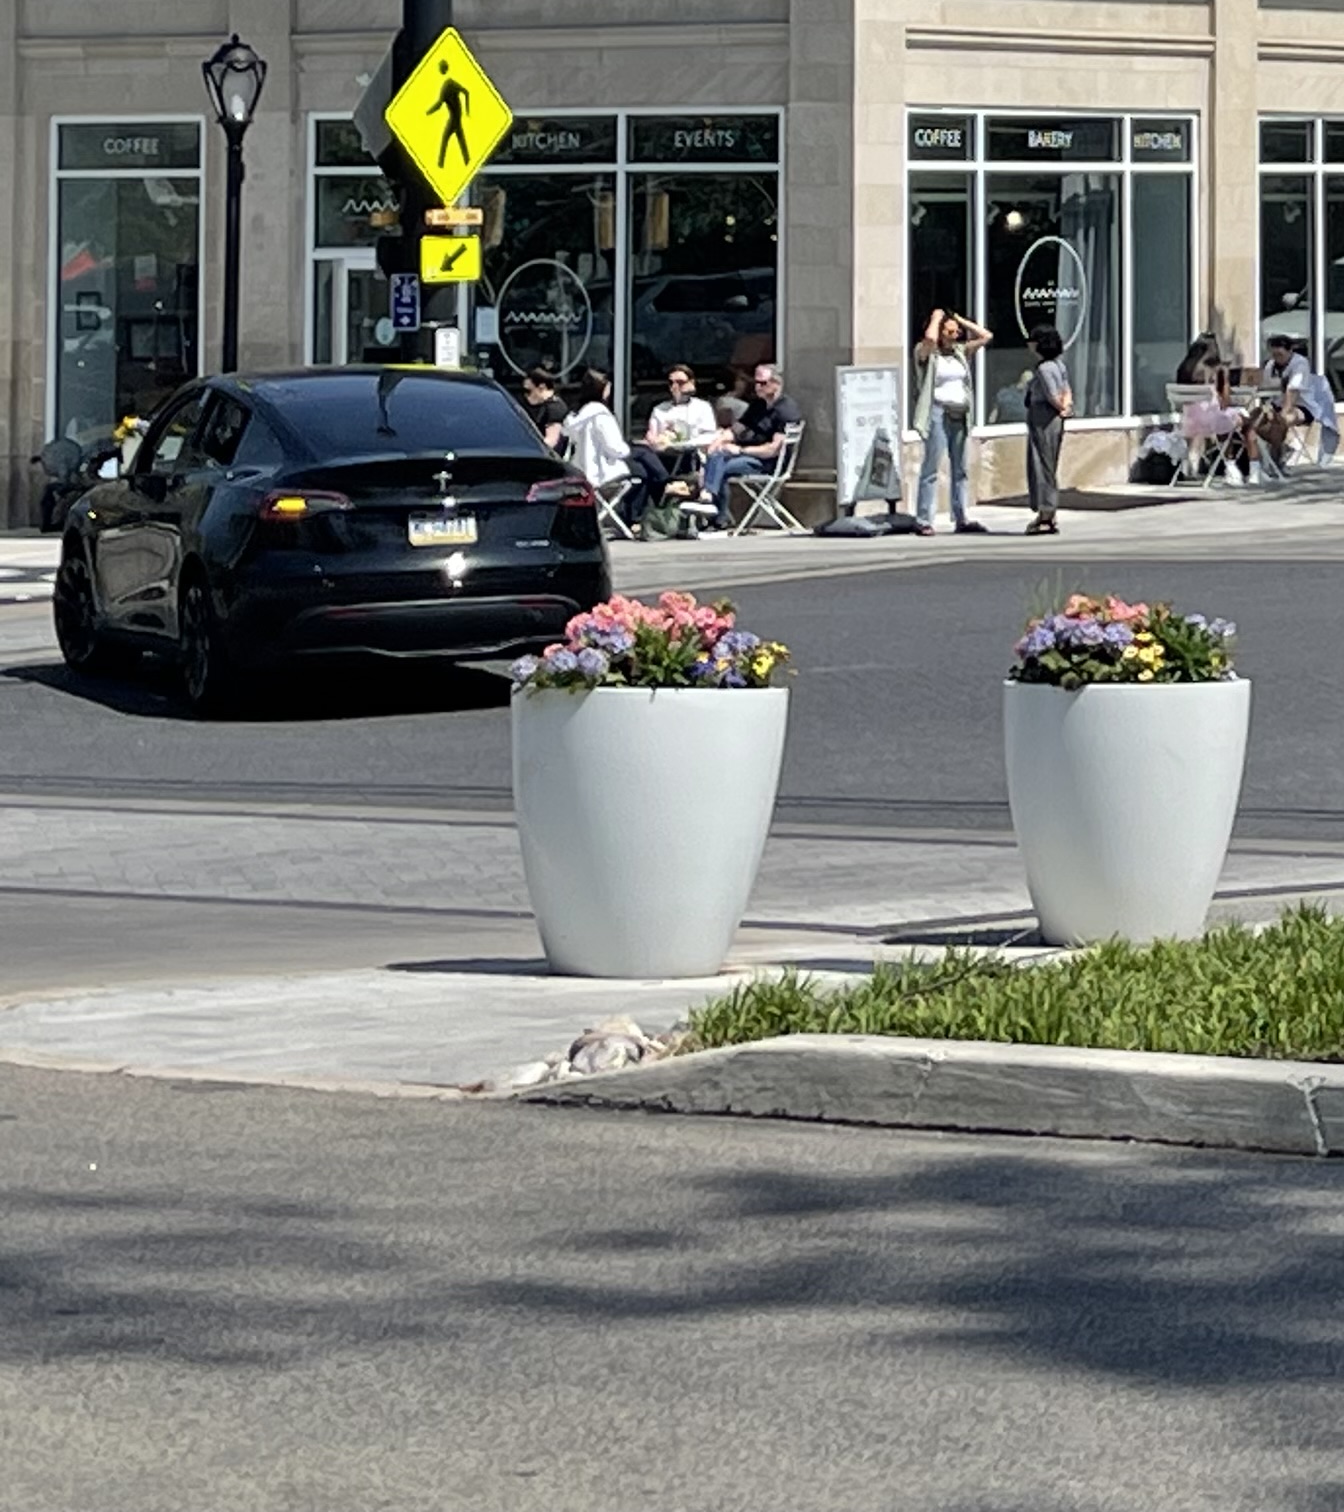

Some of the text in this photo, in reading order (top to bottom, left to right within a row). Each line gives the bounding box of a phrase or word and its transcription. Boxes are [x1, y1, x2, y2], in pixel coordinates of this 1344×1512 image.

[103, 137, 160, 155] COFFEE
[511, 131, 581, 150] KITCHEN
[674, 129, 735, 148] EVENTS
[914, 128, 962, 148] COFFEE
[1028, 129, 1074, 149] BAKERY
